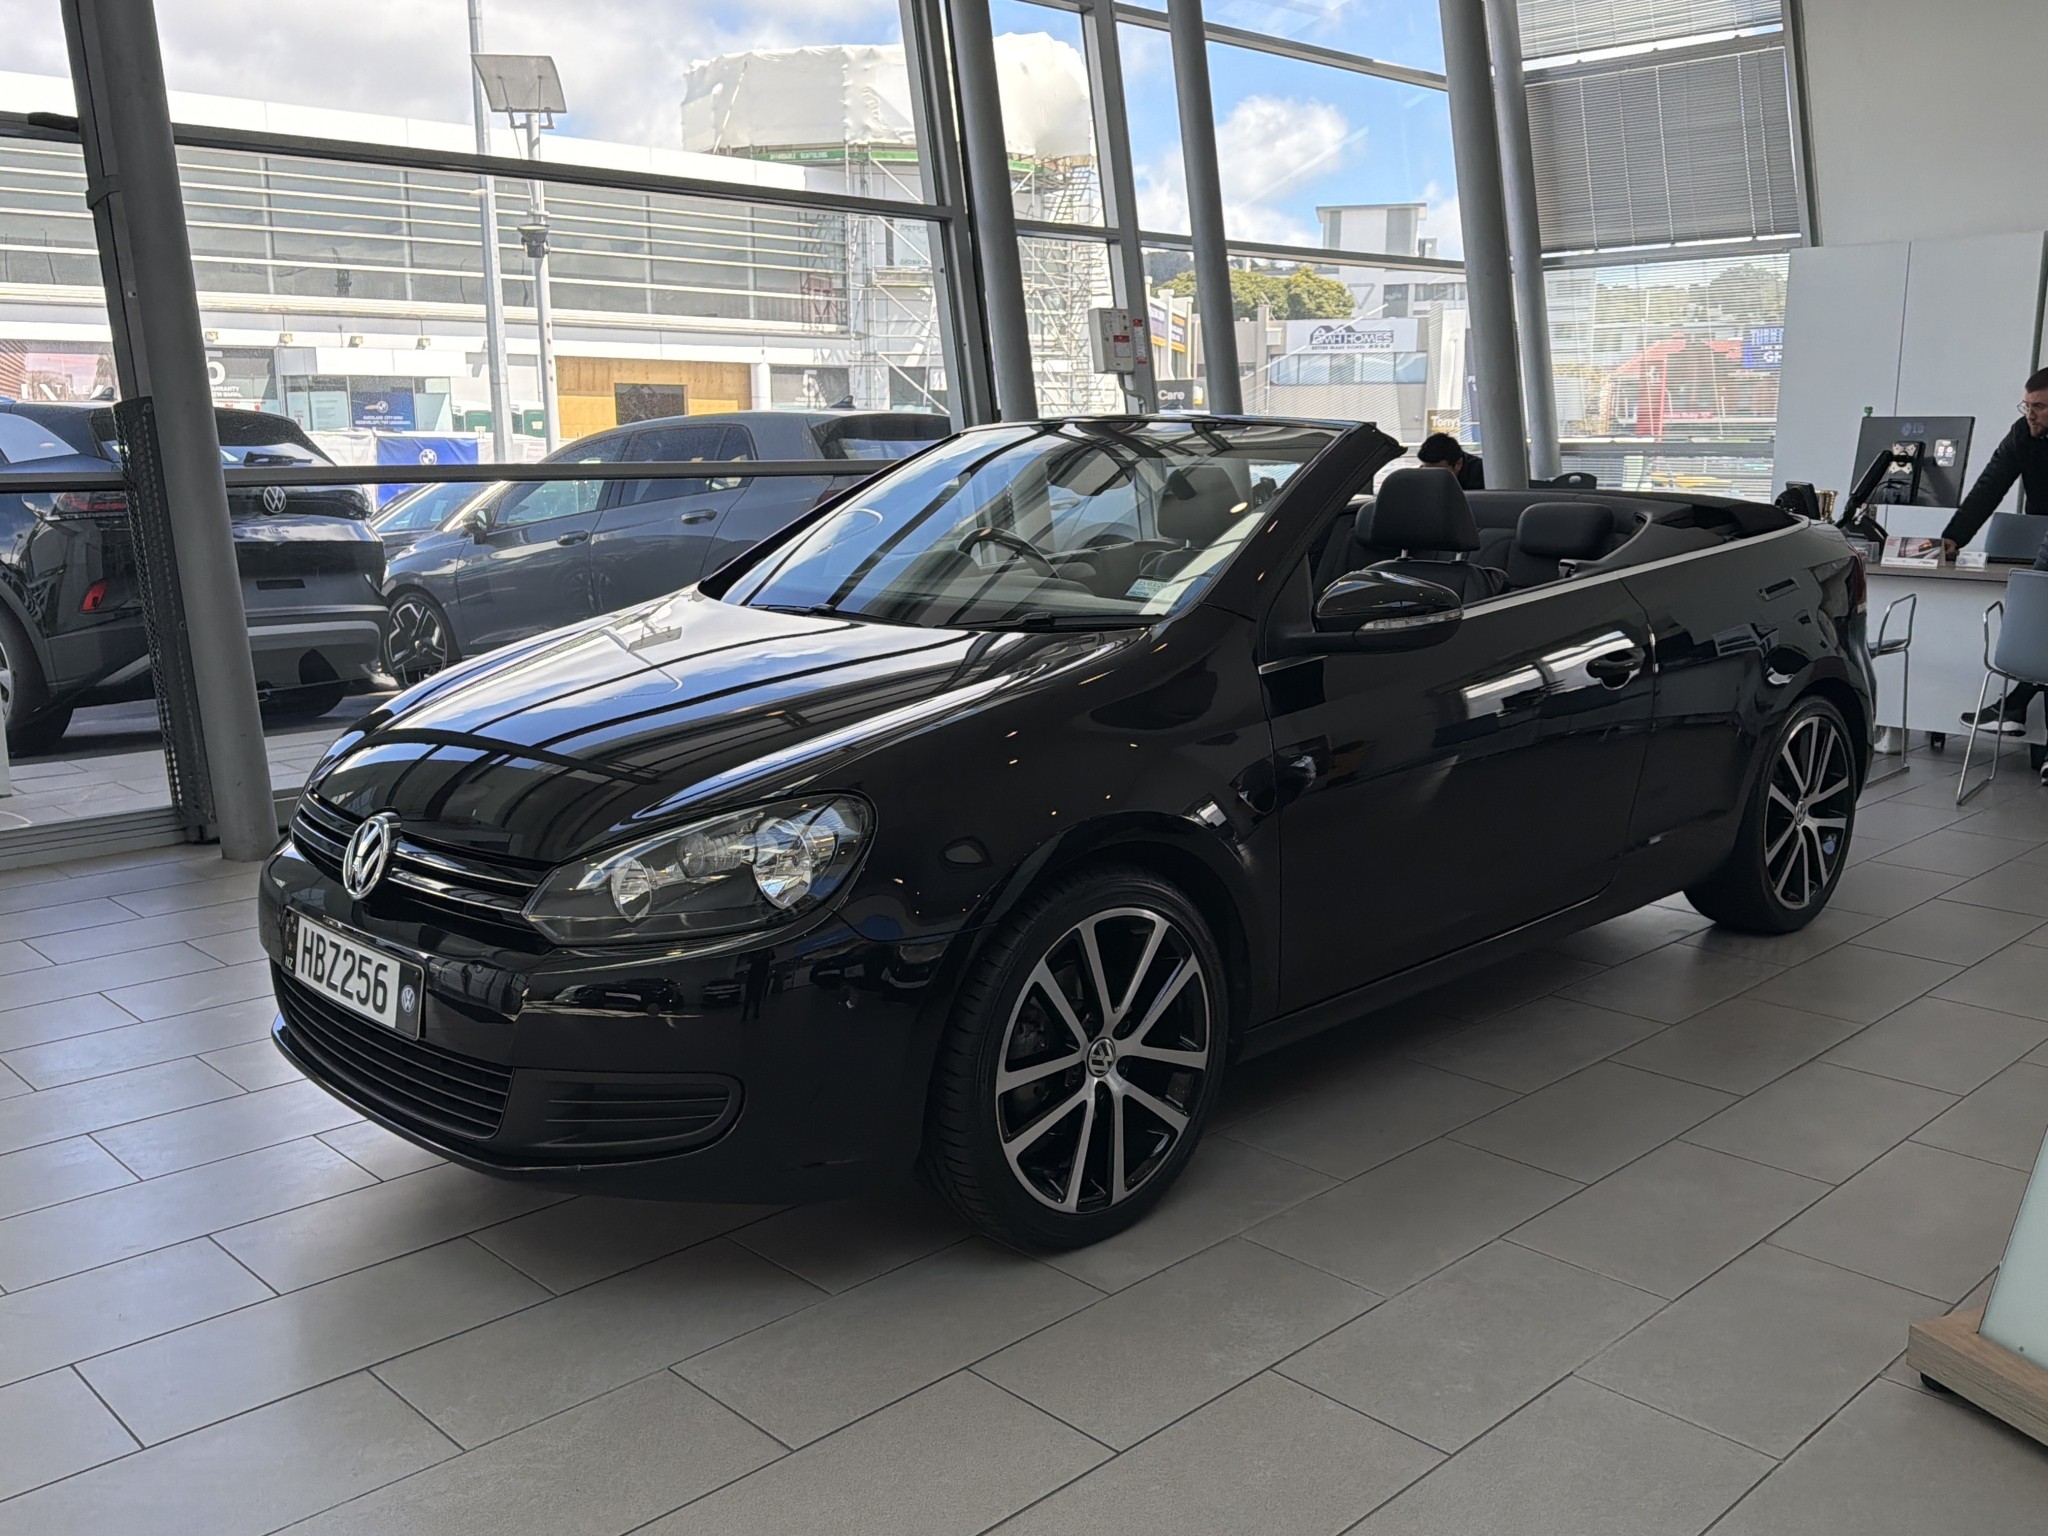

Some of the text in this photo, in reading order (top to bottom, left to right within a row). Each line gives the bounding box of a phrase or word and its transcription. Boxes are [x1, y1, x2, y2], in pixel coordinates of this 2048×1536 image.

[1344, 332, 1393, 344] HOMES
[1157, 389, 1185, 400] Care
[284, 954, 295, 971] NZ
[301, 926, 389, 1015] HBZ256
